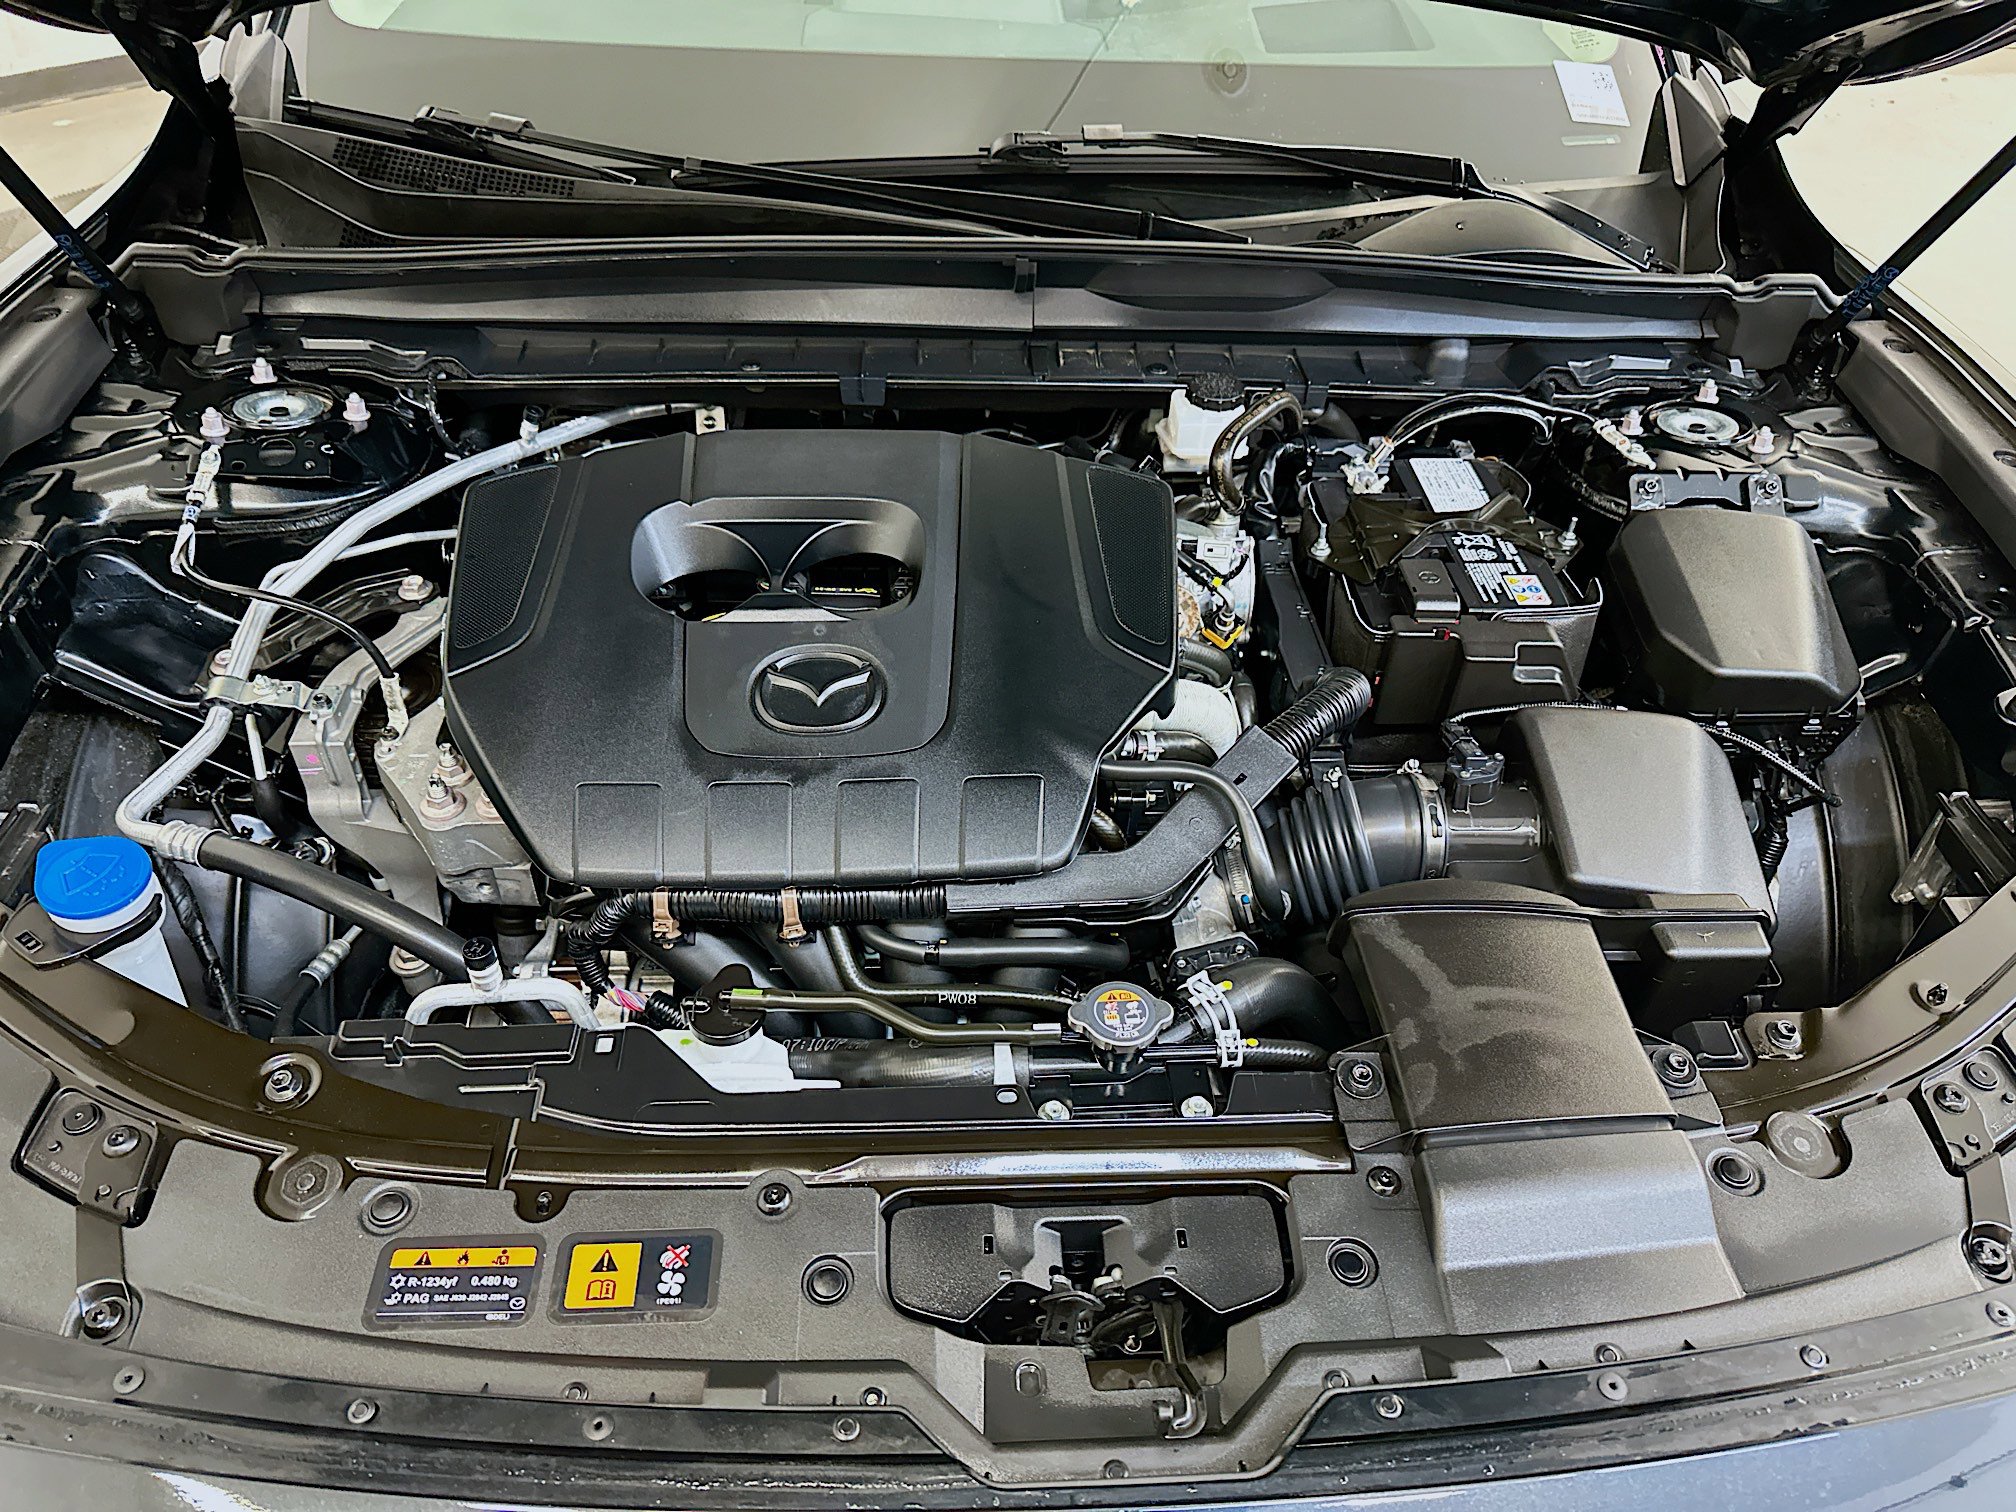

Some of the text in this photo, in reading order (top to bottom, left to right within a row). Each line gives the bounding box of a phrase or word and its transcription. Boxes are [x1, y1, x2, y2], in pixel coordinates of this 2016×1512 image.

[938, 992, 977, 1005] PW08
[407, 1275, 459, 1289] R-1234yf
[502, 1275, 518, 1288] kg
[403, 1293, 430, 1304] PAG
